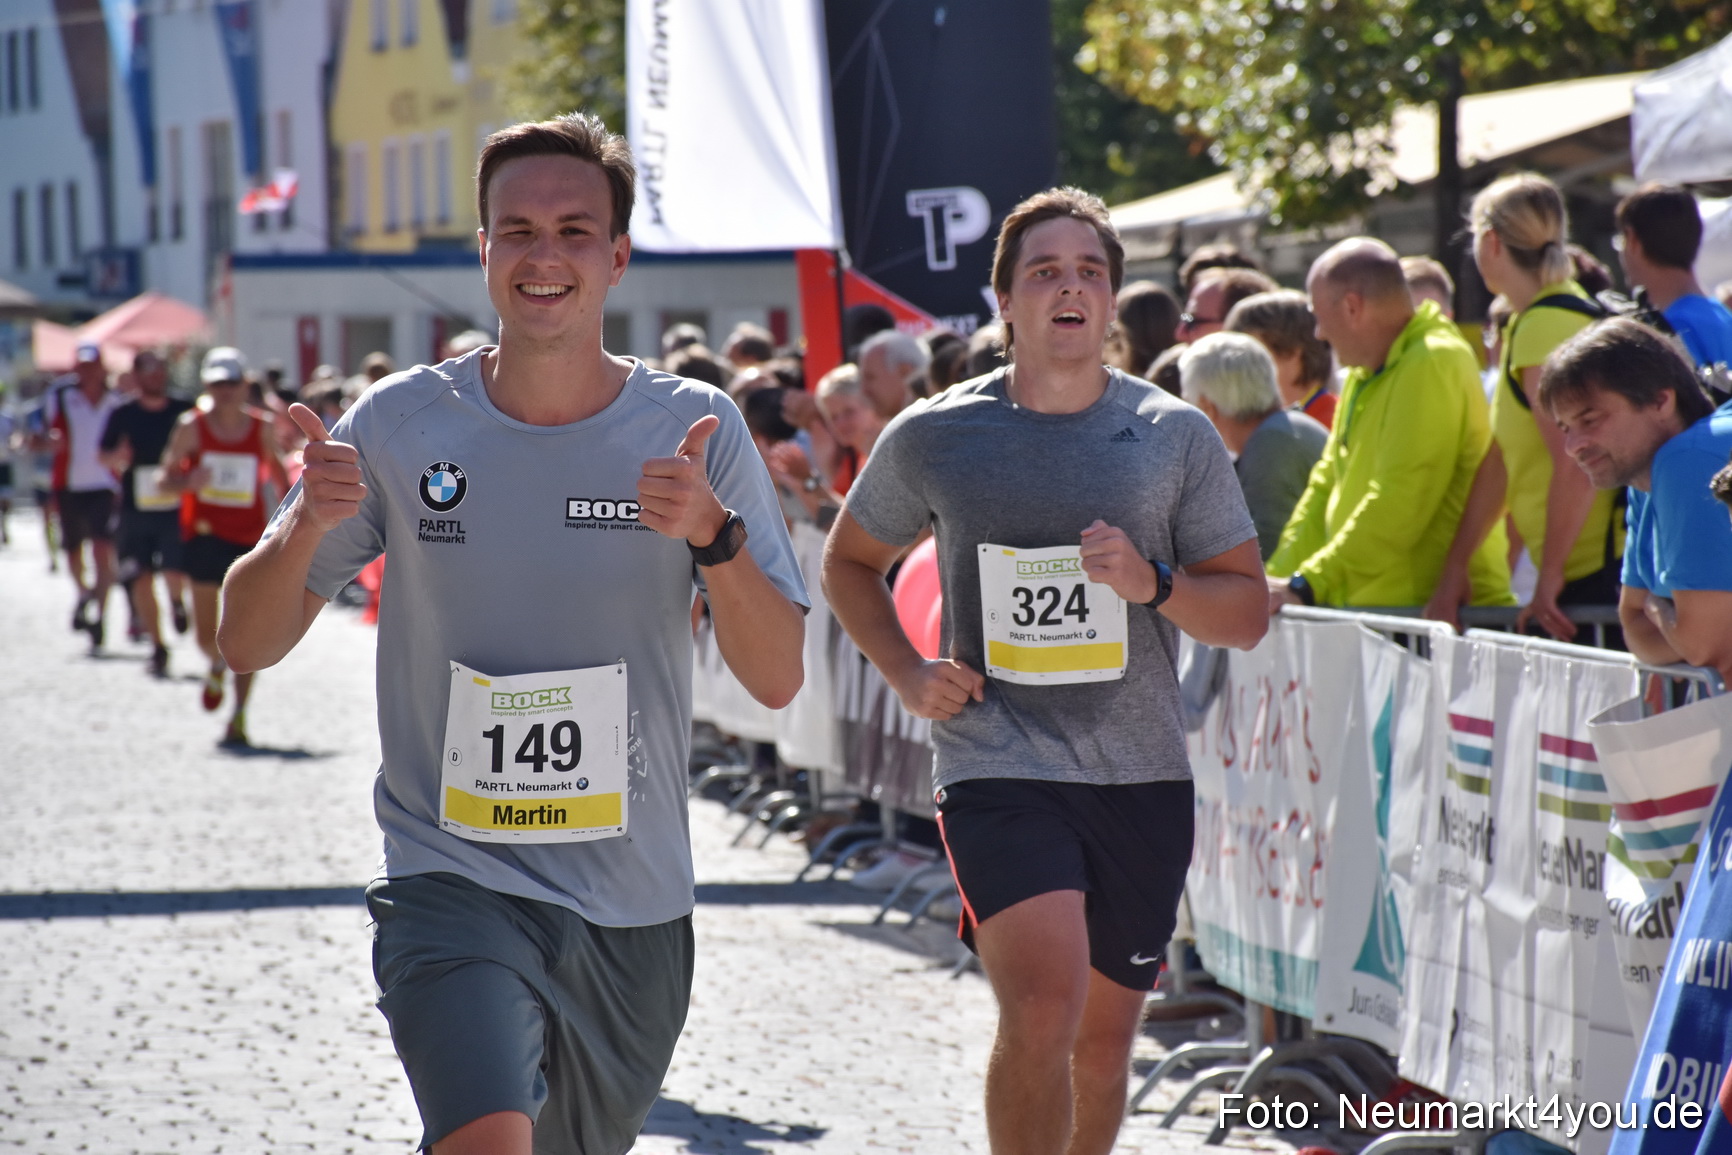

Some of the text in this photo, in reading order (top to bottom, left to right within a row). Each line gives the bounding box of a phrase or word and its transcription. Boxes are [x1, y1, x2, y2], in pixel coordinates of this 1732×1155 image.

[424, 462, 466, 480] BMW
[566, 497, 645, 522] BOC
[418, 518, 467, 534] PARTL
[564, 520, 597, 531] inspired
[598, 521, 609, 531] by
[610, 522, 633, 531] smart
[417, 531, 466, 545] Neumarkt
[1016, 558, 1081, 575] BOCK
[1012, 583, 1090, 627] 324
[1009, 631, 1083, 642] PARTL Neumarkt
[491, 686, 572, 710] BOCK
[490, 705, 574, 718] inspired by smart concepts
[482, 720, 582, 774] 149
[475, 779, 573, 793] PARTL Neumarkt
[492, 804, 568, 826] Martin
